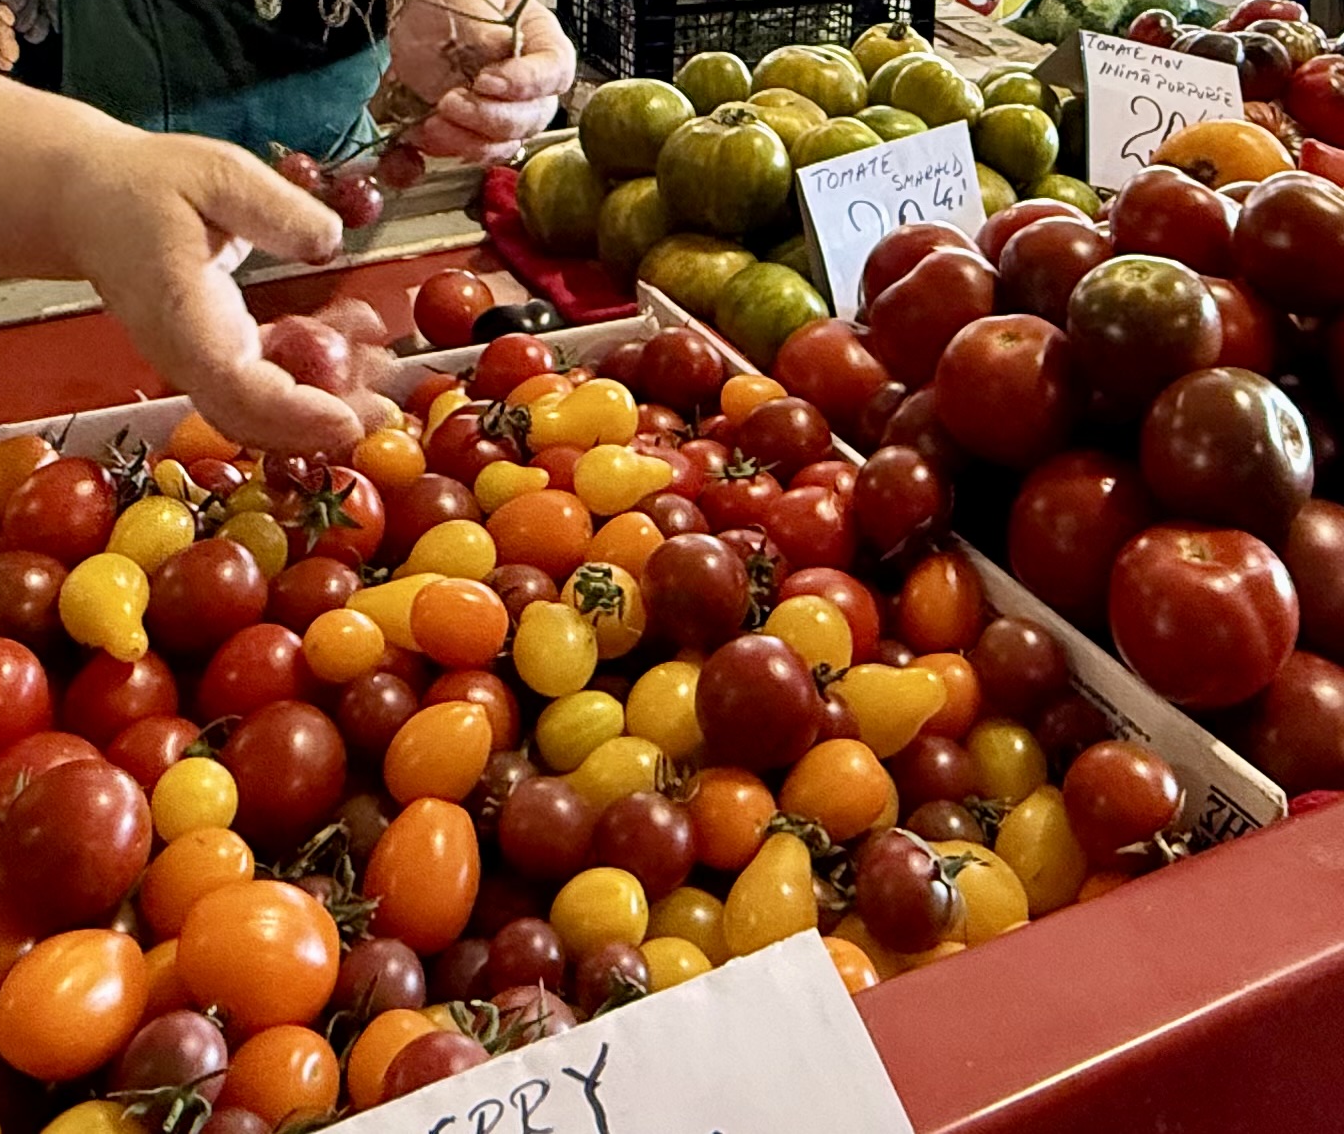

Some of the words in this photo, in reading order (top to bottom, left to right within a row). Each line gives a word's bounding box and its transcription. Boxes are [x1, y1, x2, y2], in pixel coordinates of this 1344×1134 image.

[1086, 34, 1146, 60] TOMATE
[1151, 54, 1183, 70] MOV
[810, 150, 894, 193] TOMATE
